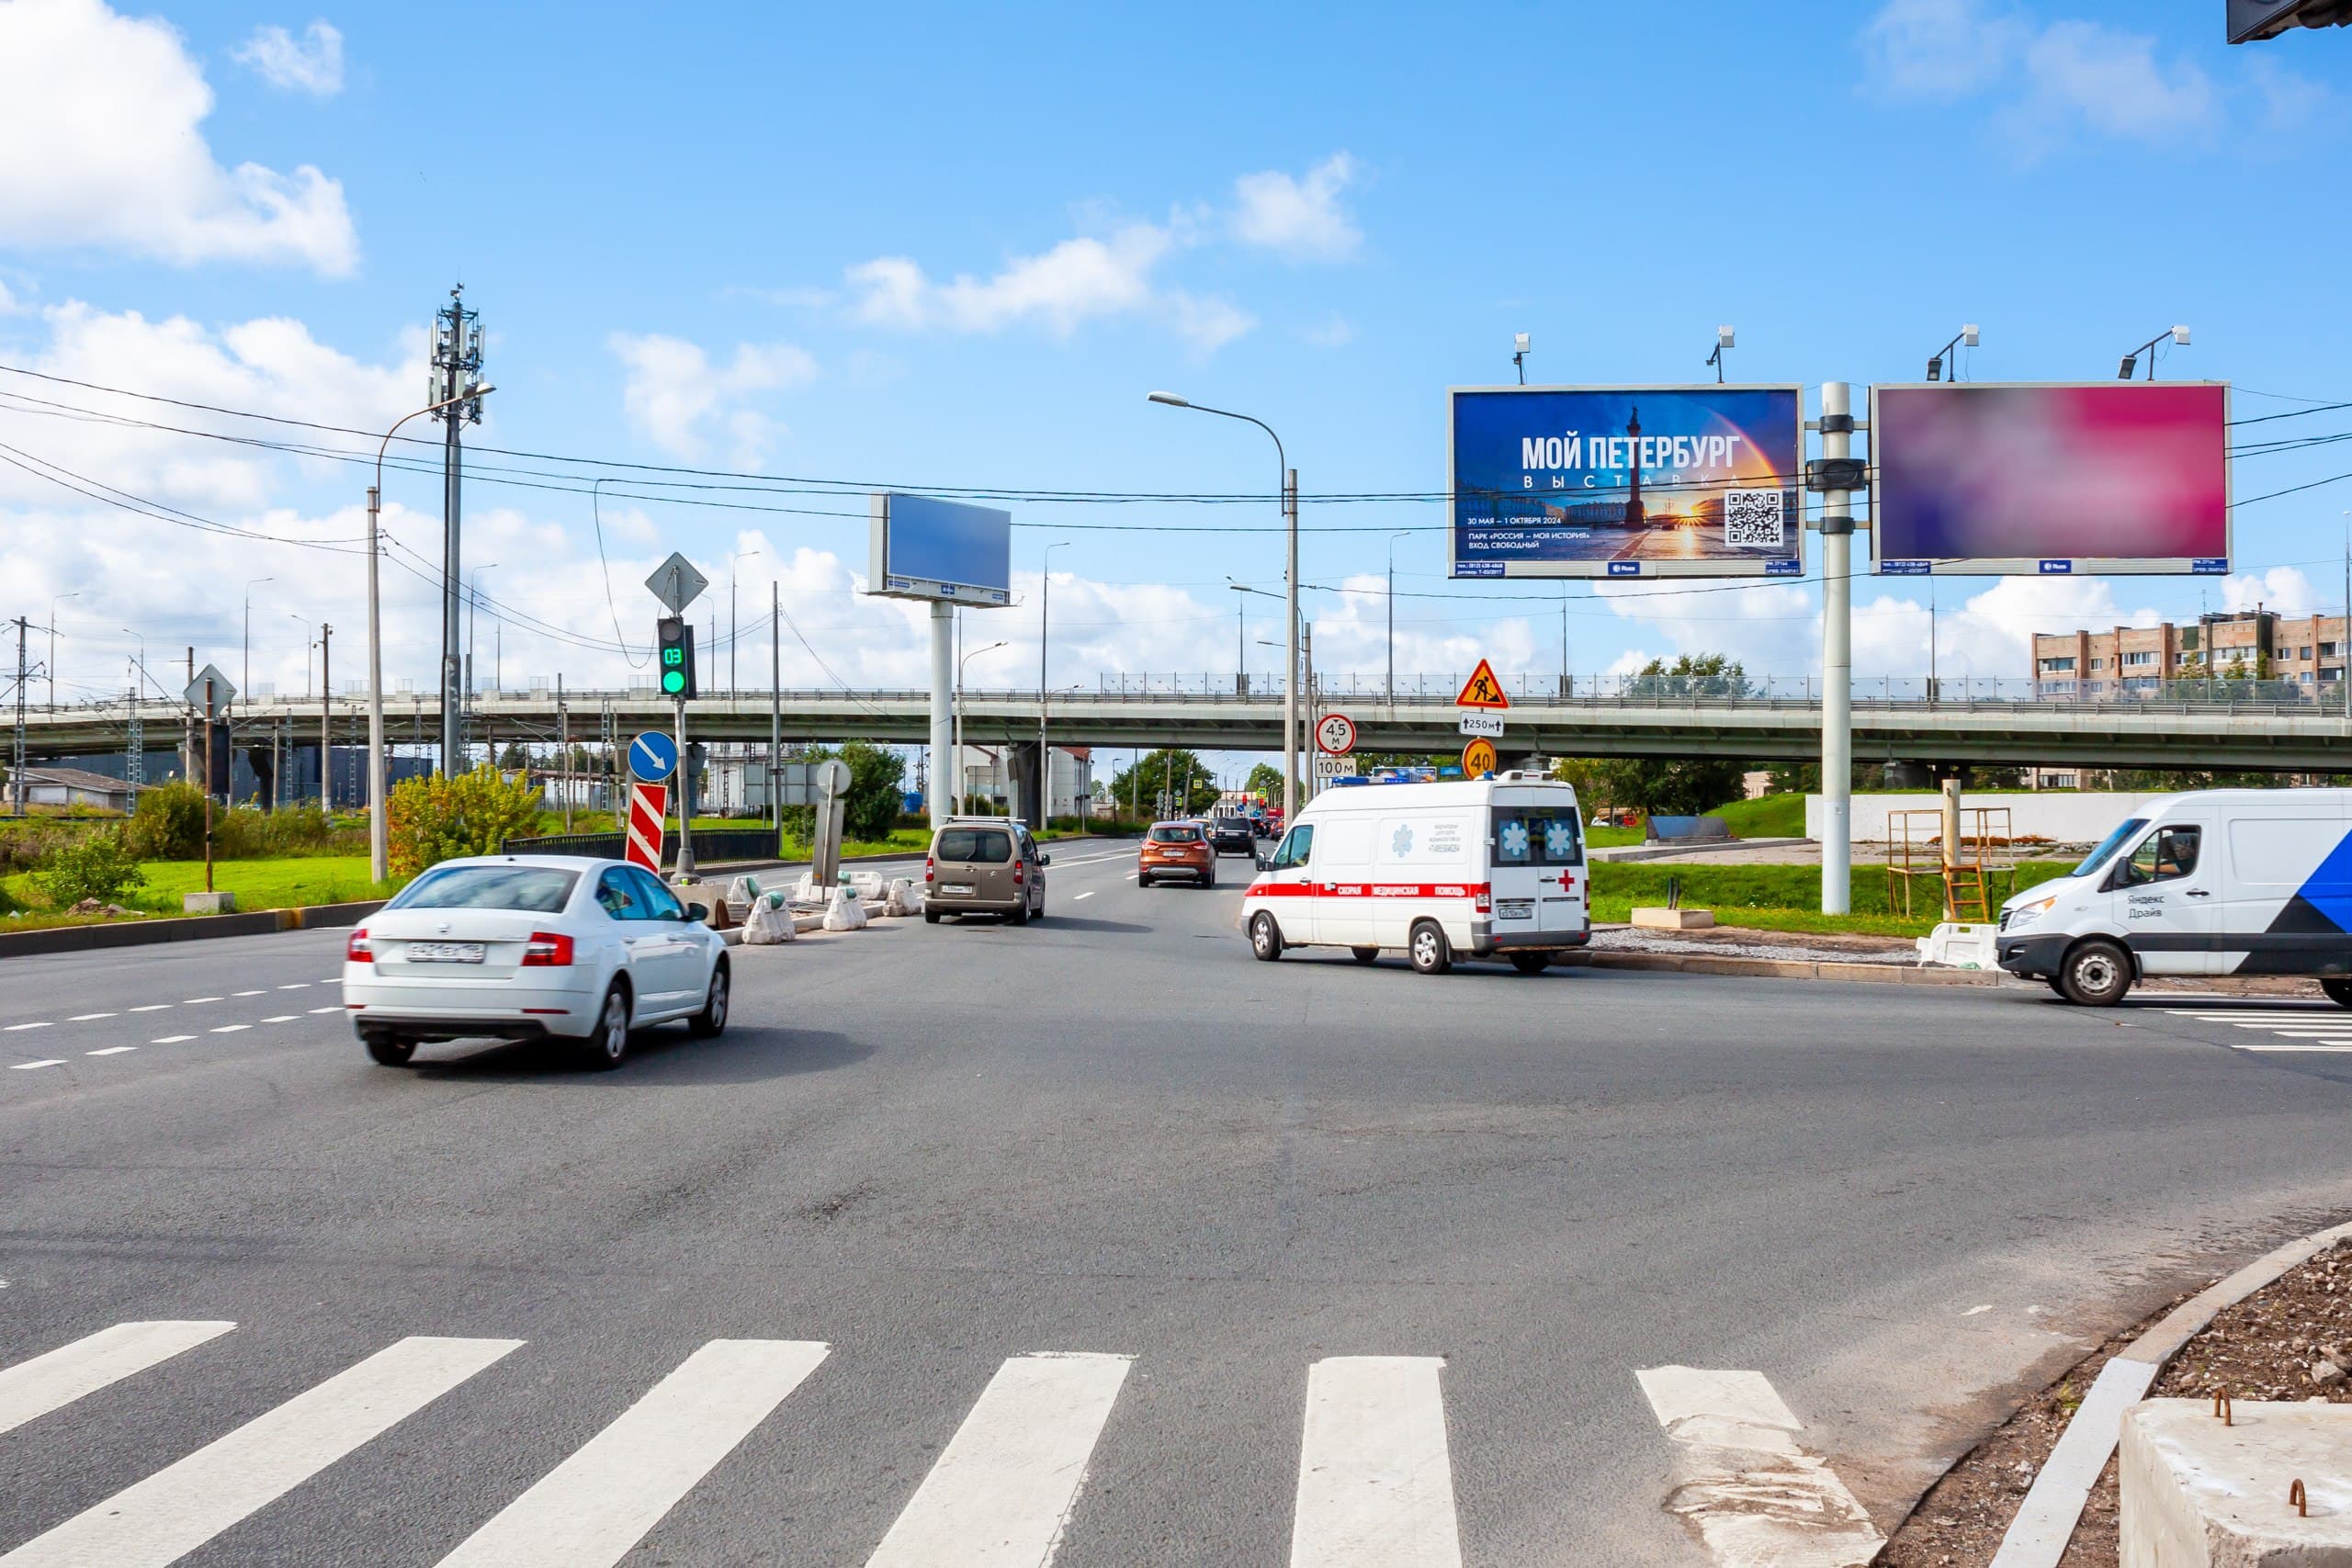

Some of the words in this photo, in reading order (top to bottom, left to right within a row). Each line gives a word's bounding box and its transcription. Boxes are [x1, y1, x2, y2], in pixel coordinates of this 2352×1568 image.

[1521, 430, 1581, 469] МОЙ
[1589, 435, 1740, 469] ПЕТЕРБУРГ
[1467, 517, 1477, 525] 30
[1543, 516, 1562, 525] 2024
[1489, 532, 1524, 540] «РОССИЯ
[1552, 532, 1590, 540] ИСТОРИЯ»
[1468, 542, 1489, 550] ВХОД
[1491, 540, 1540, 549] СВОБОДНЫЙ
[664, 648, 683, 665] 03
[1469, 719, 1495, 729] 250м
[1318, 761, 1353, 773] 100м
[1470, 752, 1490, 771] 40
[1338, 886, 1362, 896] СКОРАЯ
[1373, 886, 1419, 897] МЕДИЦИНСКАЯ
[1434, 886, 1465, 897] ПОМОЩЬ
[2128, 895, 2165, 905] Яндекс
[2128, 908, 2163, 919] Драйв
